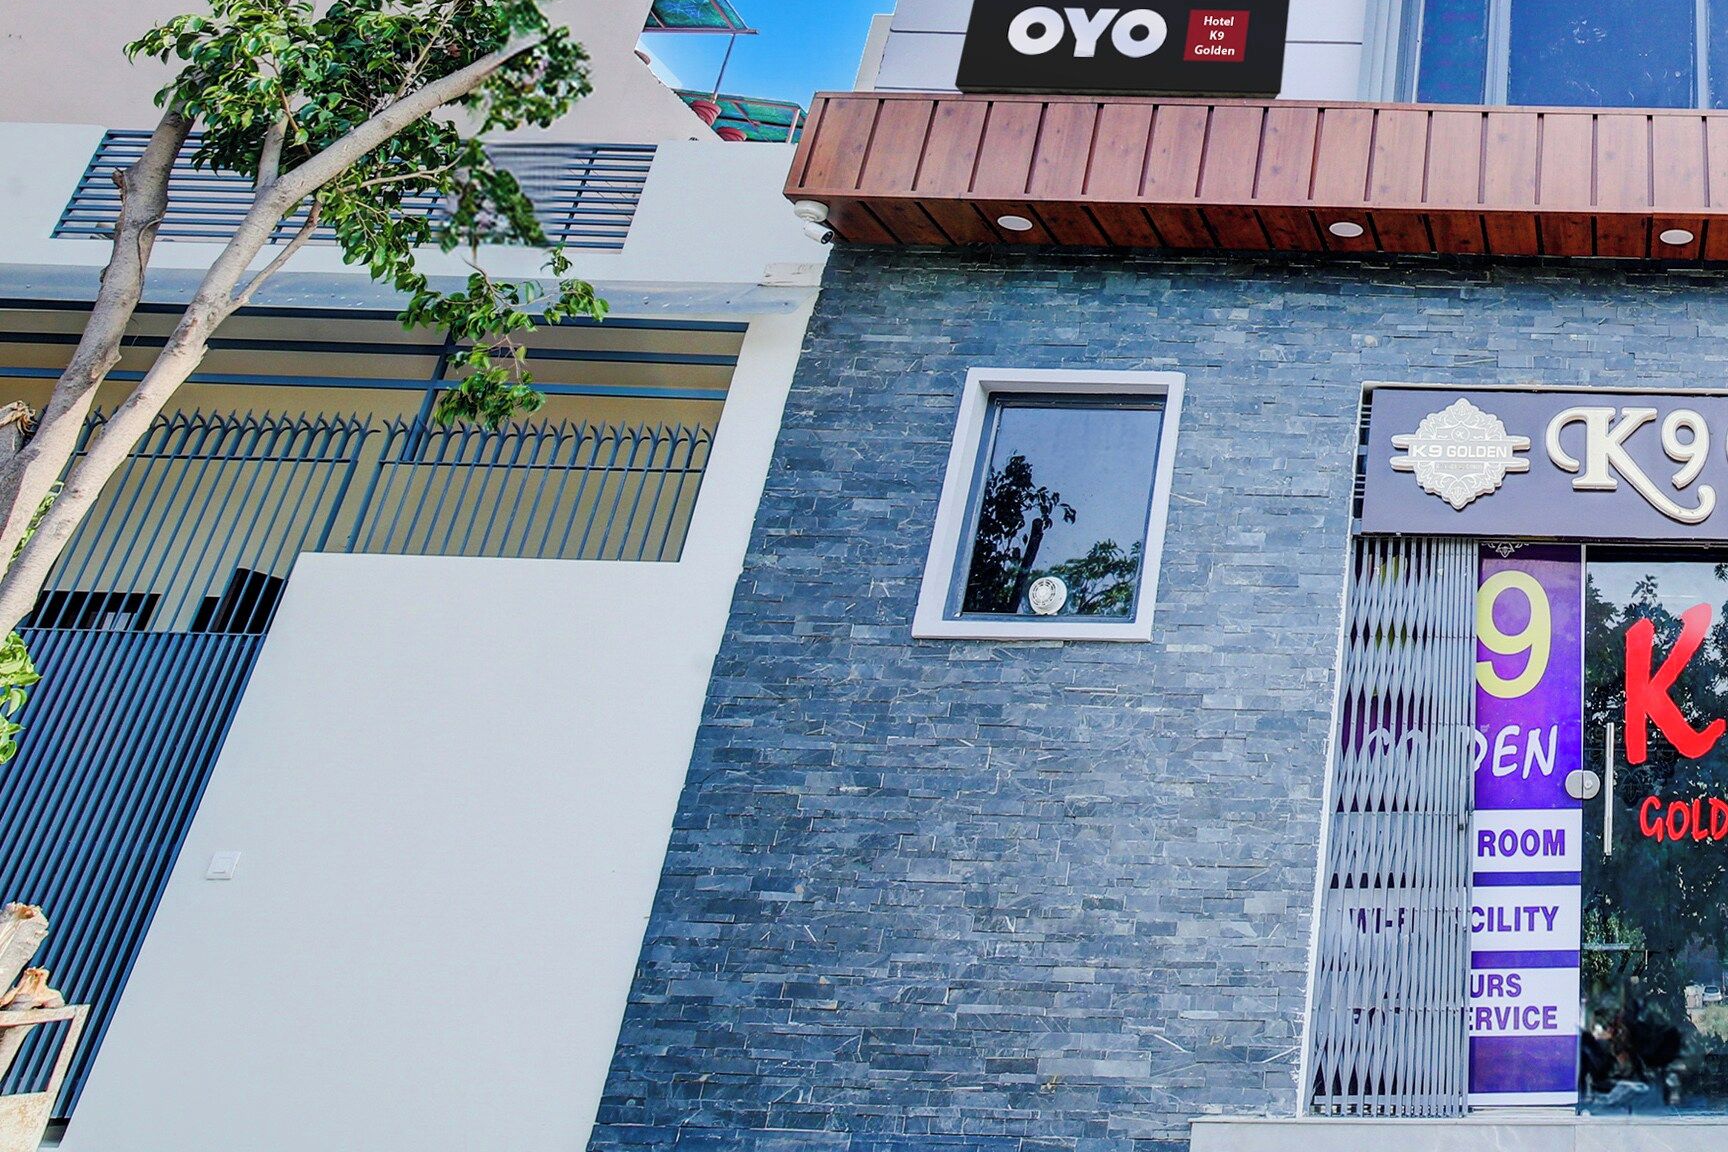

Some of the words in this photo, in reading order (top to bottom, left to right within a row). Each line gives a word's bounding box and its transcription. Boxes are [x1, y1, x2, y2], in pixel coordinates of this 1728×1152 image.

[1007, 6, 1168, 59] OYO
[1203, 15, 1235, 27] Hotel
[1209, 29, 1226, 41] K9
[1194, 44, 1236, 56] Golden
[1411, 444, 1443, 458] K9
[1446, 445, 1508, 458] GOLDEN
[1546, 406, 1715, 524] K9
[1477, 828, 1566, 858] ROOM
[1471, 905, 1559, 933] CILITY
[1470, 973, 1522, 998] URS
[1469, 1005, 1558, 1030] RVICE
